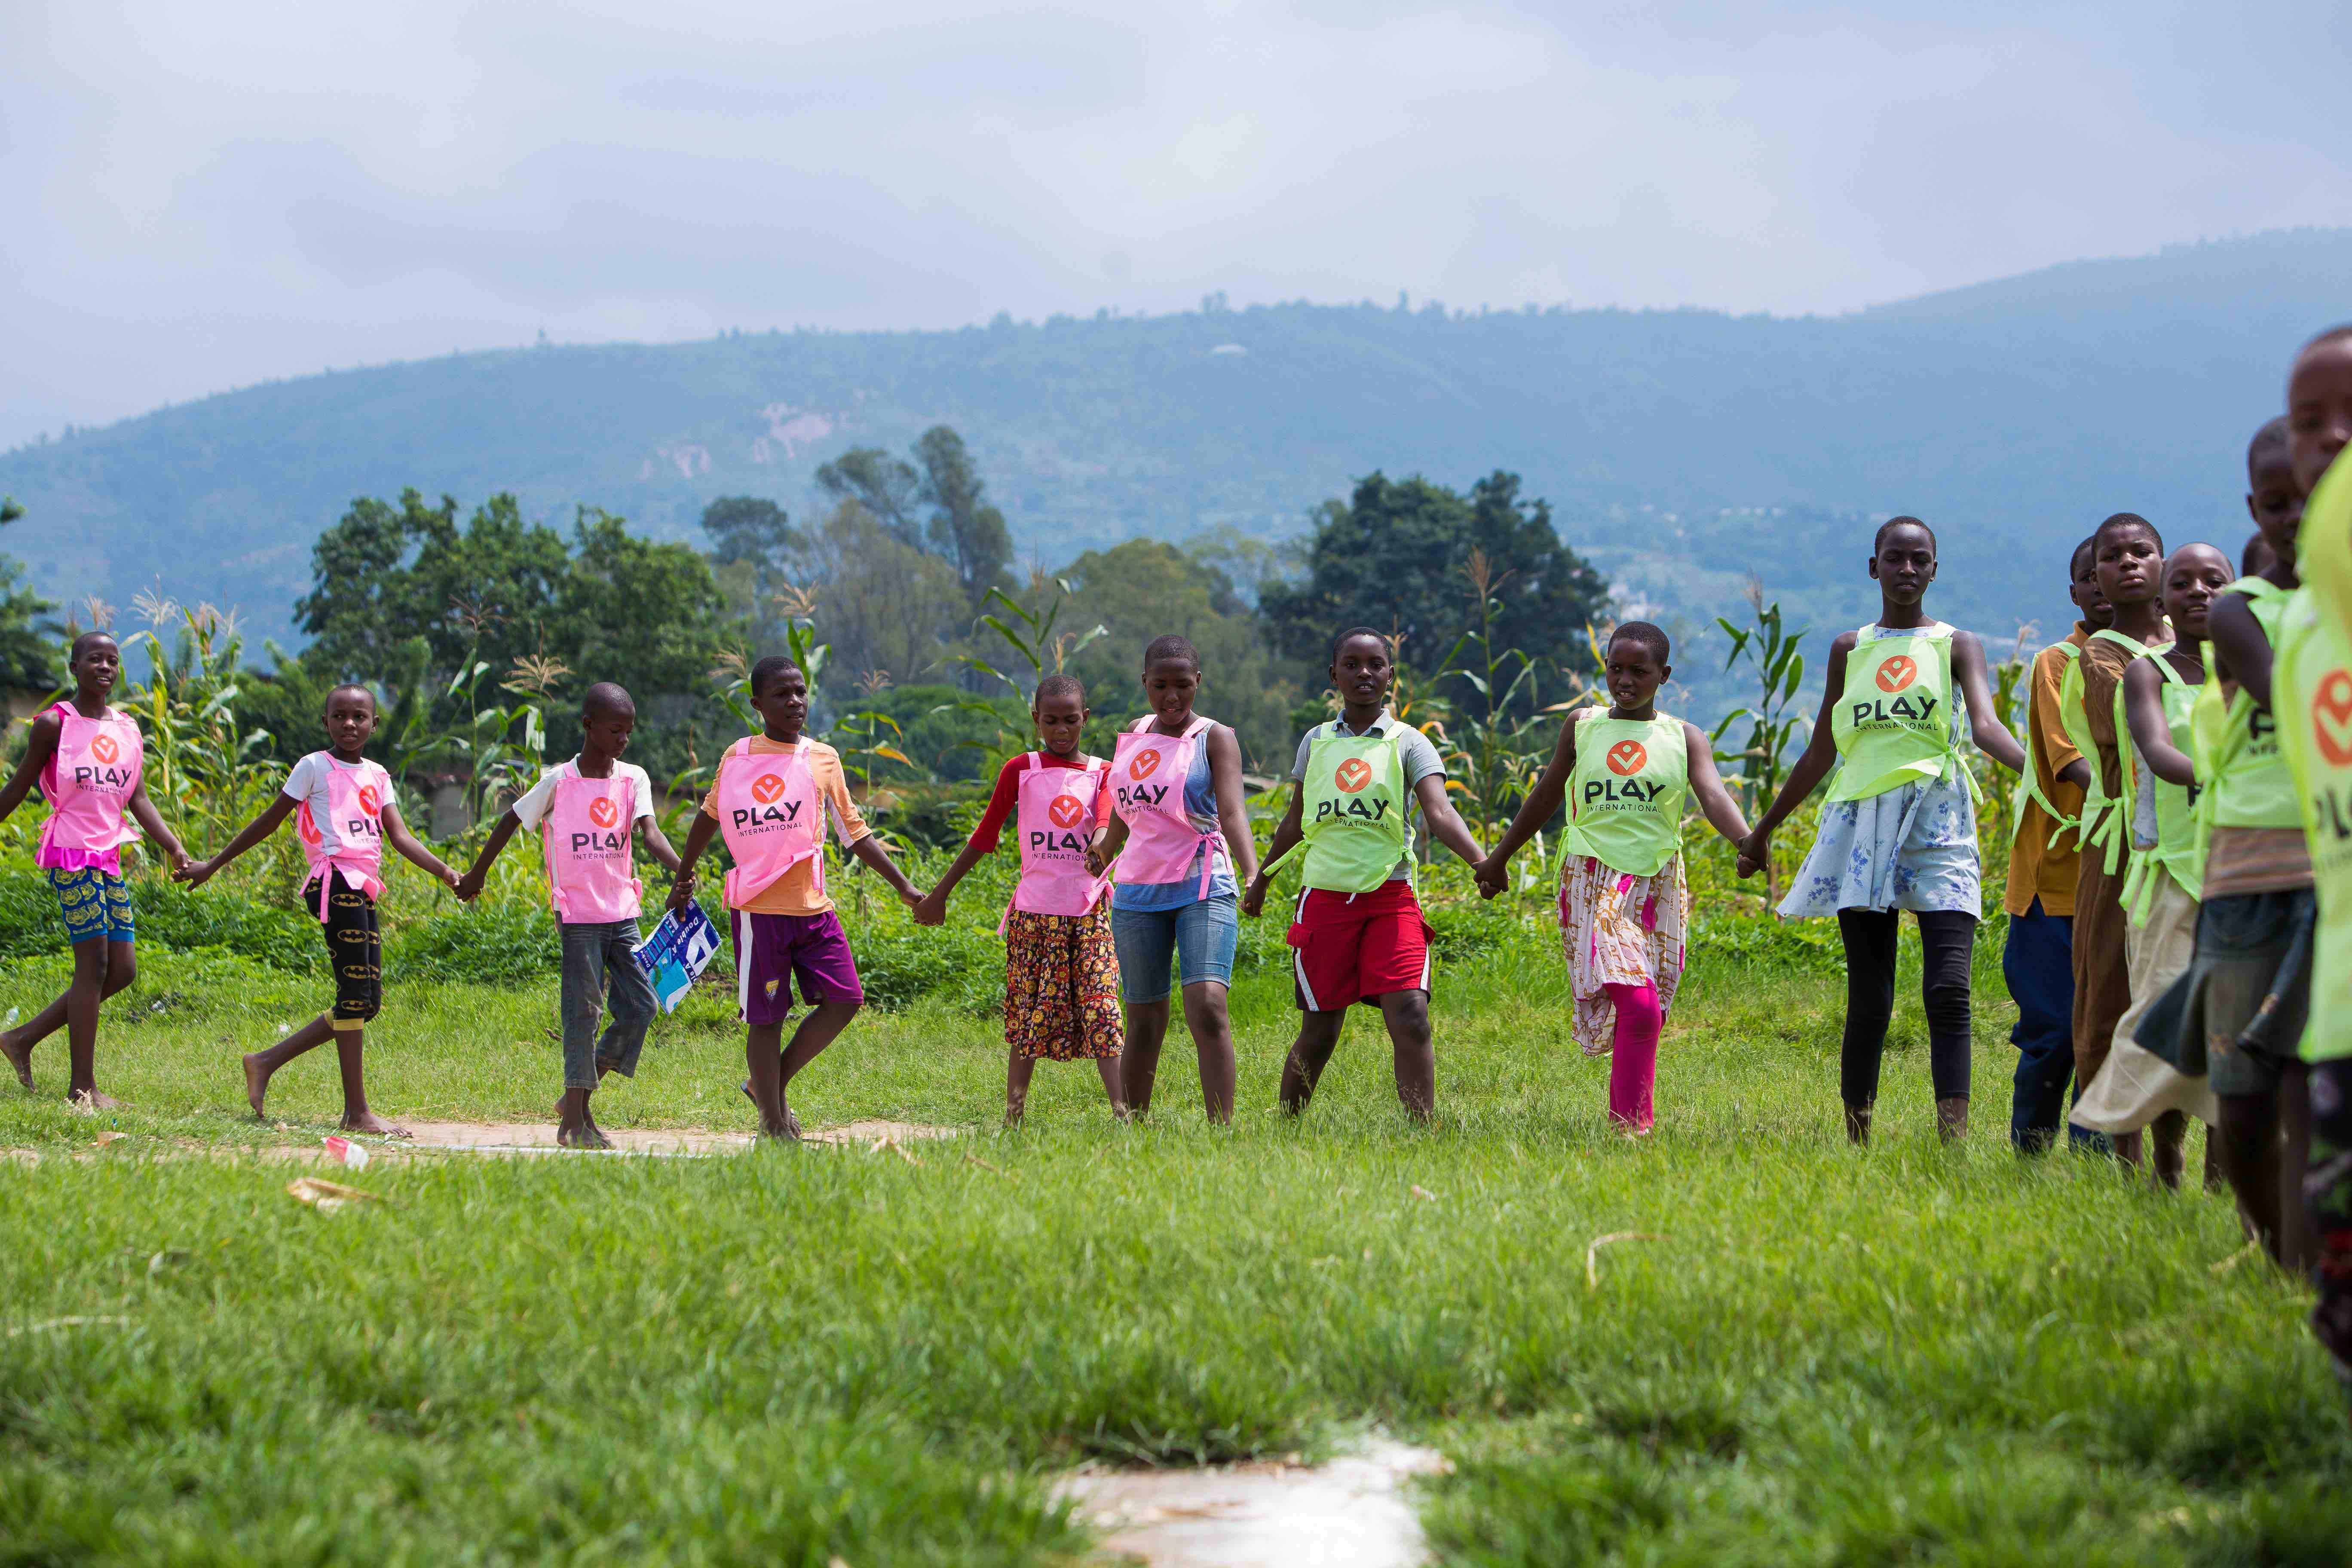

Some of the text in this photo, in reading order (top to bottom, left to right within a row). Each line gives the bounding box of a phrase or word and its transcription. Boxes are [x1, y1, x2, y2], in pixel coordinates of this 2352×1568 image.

[1853, 696, 1938, 727] PLAY
[75, 766, 132, 788] PLAY
[1117, 784, 1169, 808] PLAY
[1584, 778, 1666, 804] PLAY
[732, 800, 802, 830] PLAY
[1316, 798, 1390, 823] PLAY
[1586, 804, 1661, 813] INTERNATIONAL
[738, 821, 802, 837] INTERNATIONAL
[572, 832, 627, 852] PLAY
[1030, 831, 1093, 853] PLAY
[677, 916, 699, 945] Double
